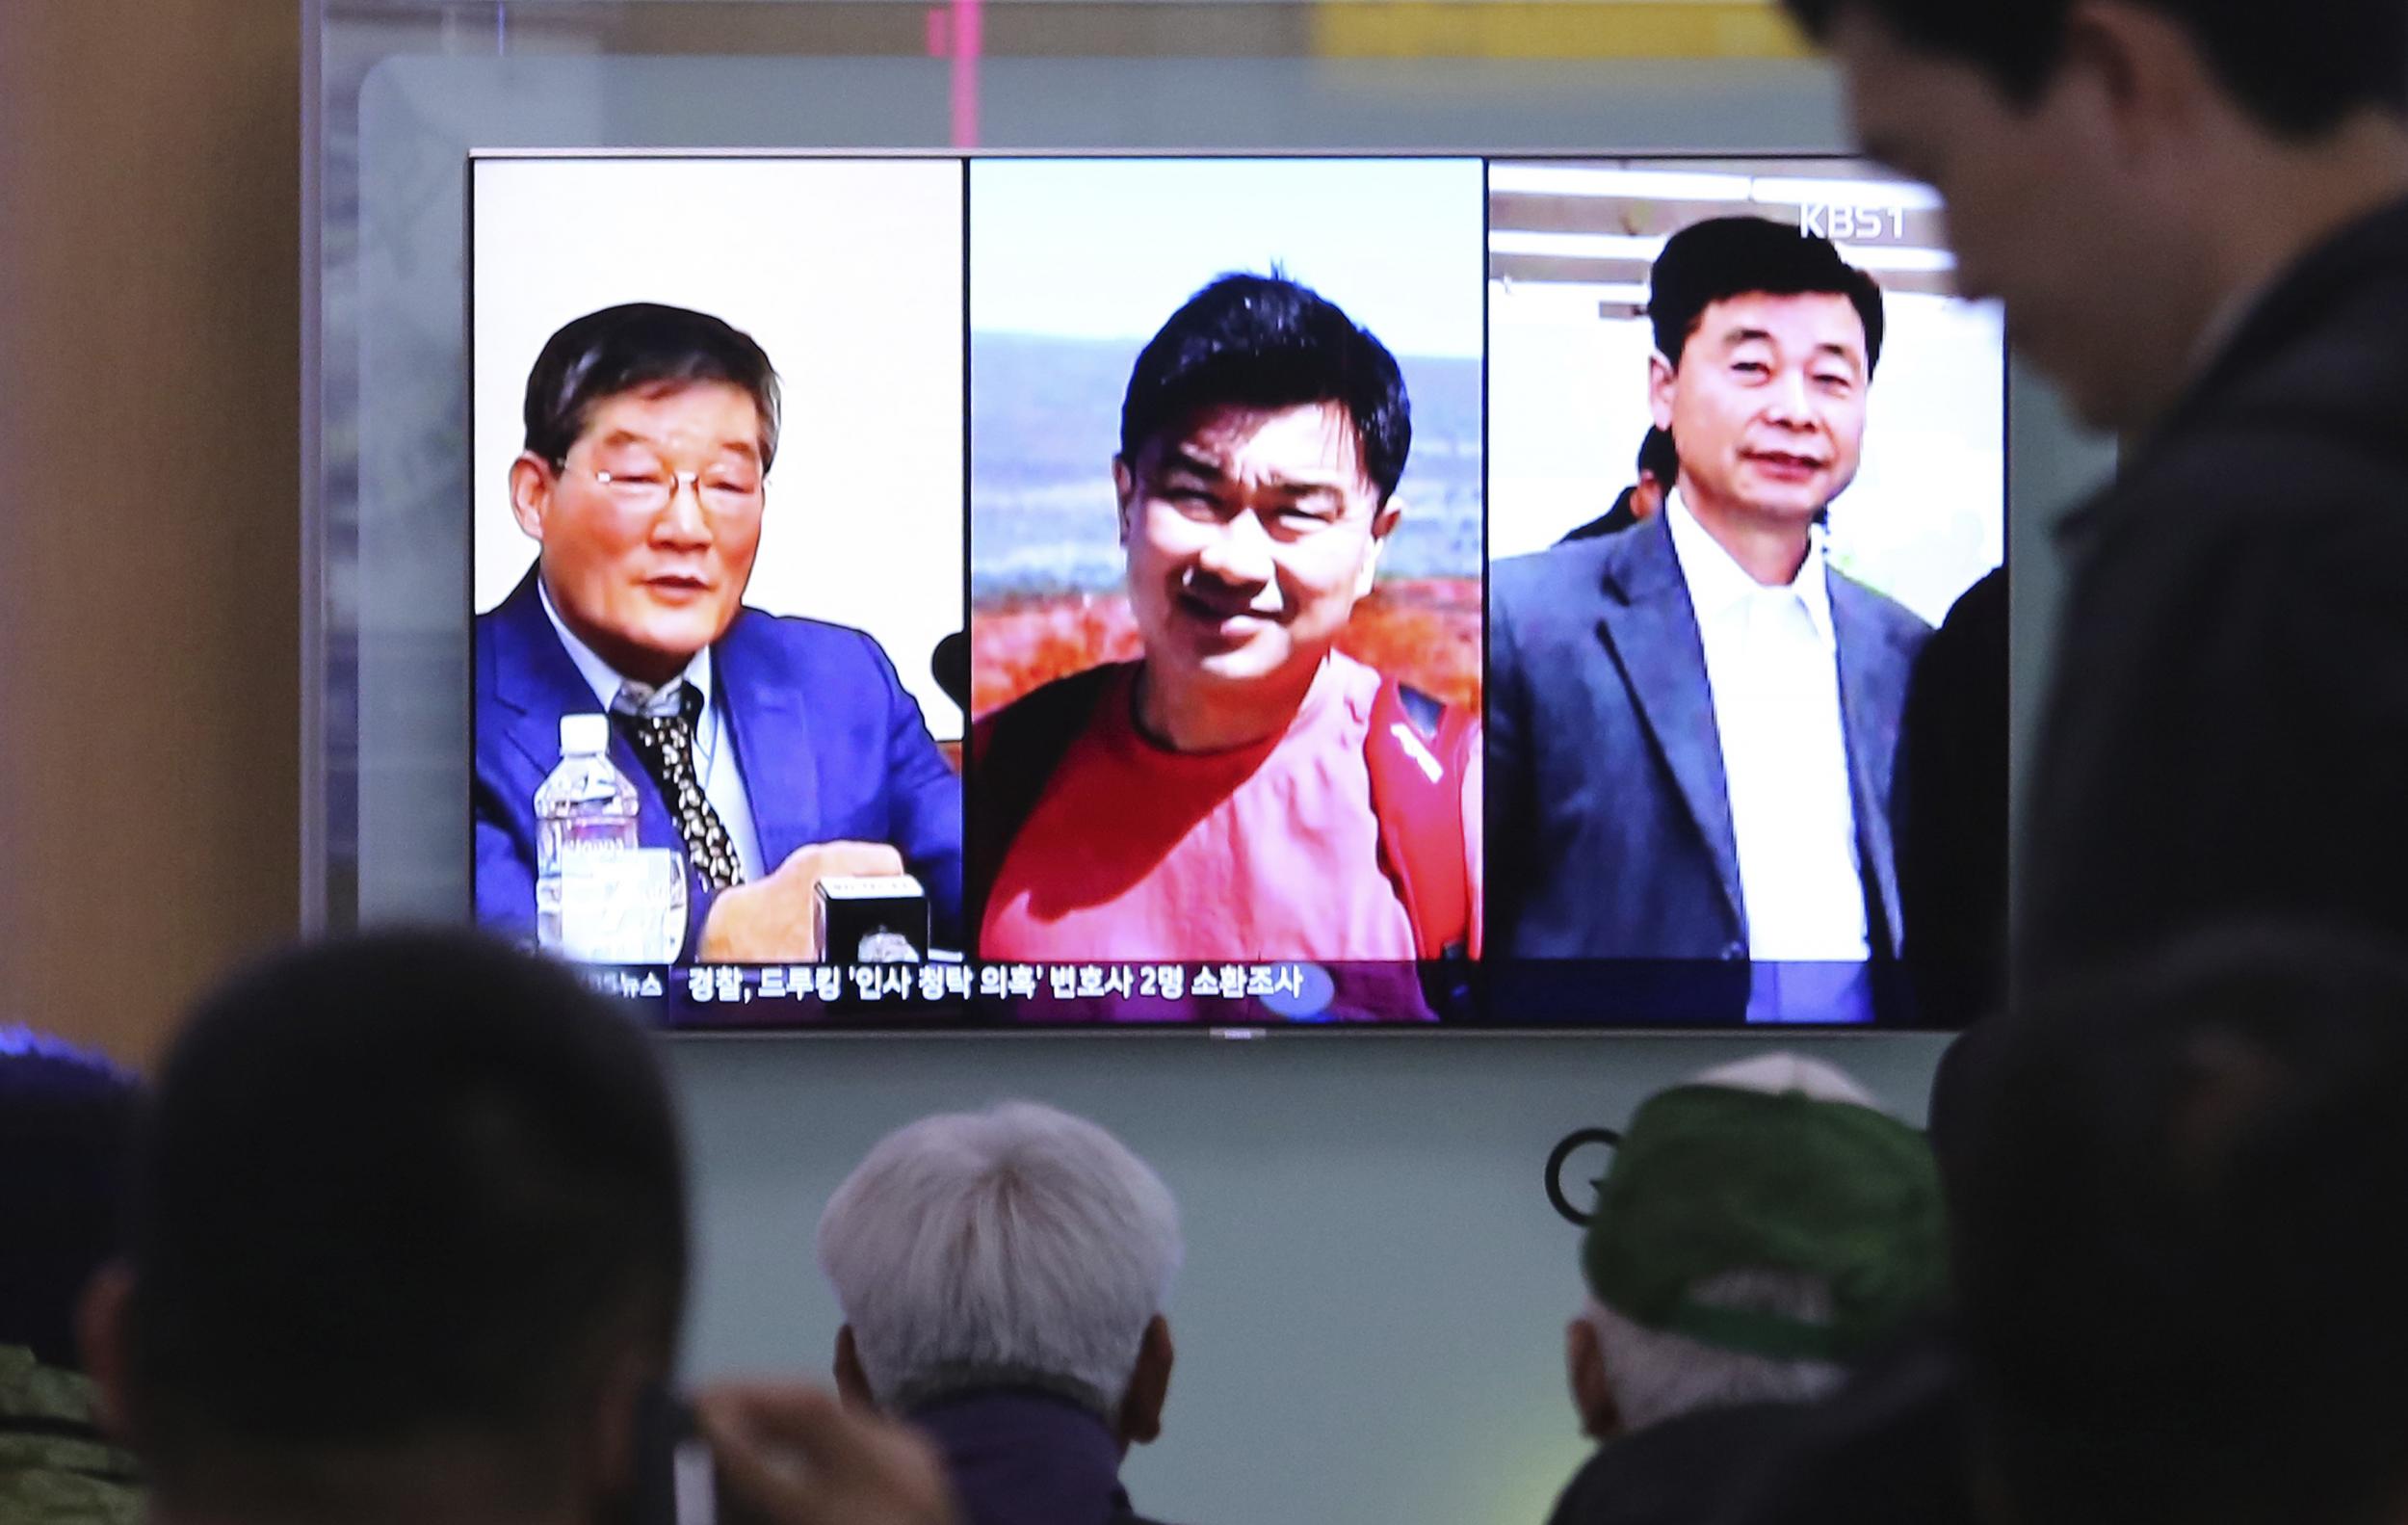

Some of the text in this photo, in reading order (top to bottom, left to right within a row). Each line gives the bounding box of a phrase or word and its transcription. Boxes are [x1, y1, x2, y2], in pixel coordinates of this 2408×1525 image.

[688, 964, 1305, 1004] 경찰, 드루킹 '인사 청탁 의혹' 변호사 2명 소환조사
